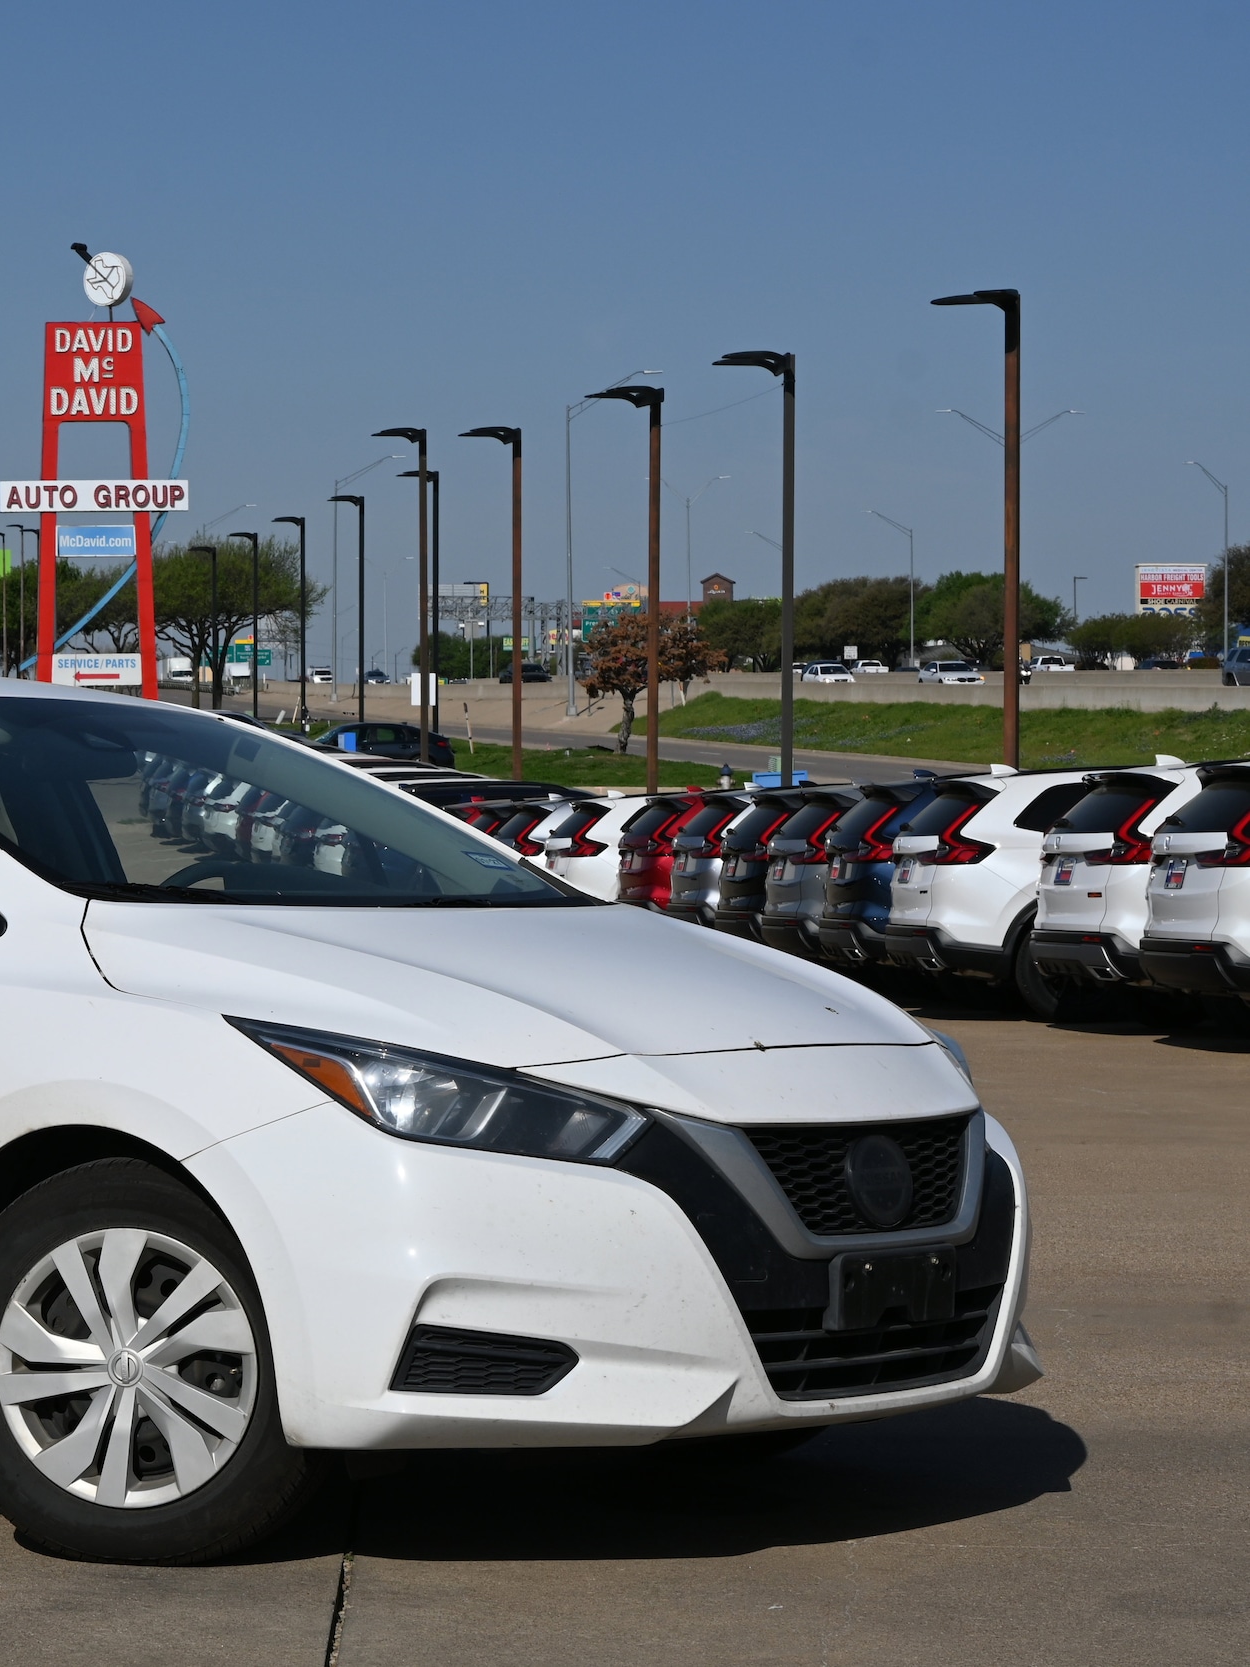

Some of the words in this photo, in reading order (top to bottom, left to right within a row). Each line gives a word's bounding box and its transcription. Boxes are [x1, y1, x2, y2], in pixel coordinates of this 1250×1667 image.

[55, 327, 133, 353] DAVID
[50, 386, 139, 415] DAVID
[6, 485, 78, 509] AUTO
[93, 484, 185, 508] GROUP
[59, 535, 132, 547] McDavid.com
[1140, 573, 1162, 581] HARBOR
[1163, 573, 1185, 581] FREIGHT
[1187, 573, 1204, 581] TOOLS
[58, 658, 137, 669] SERVICE/PARTS
